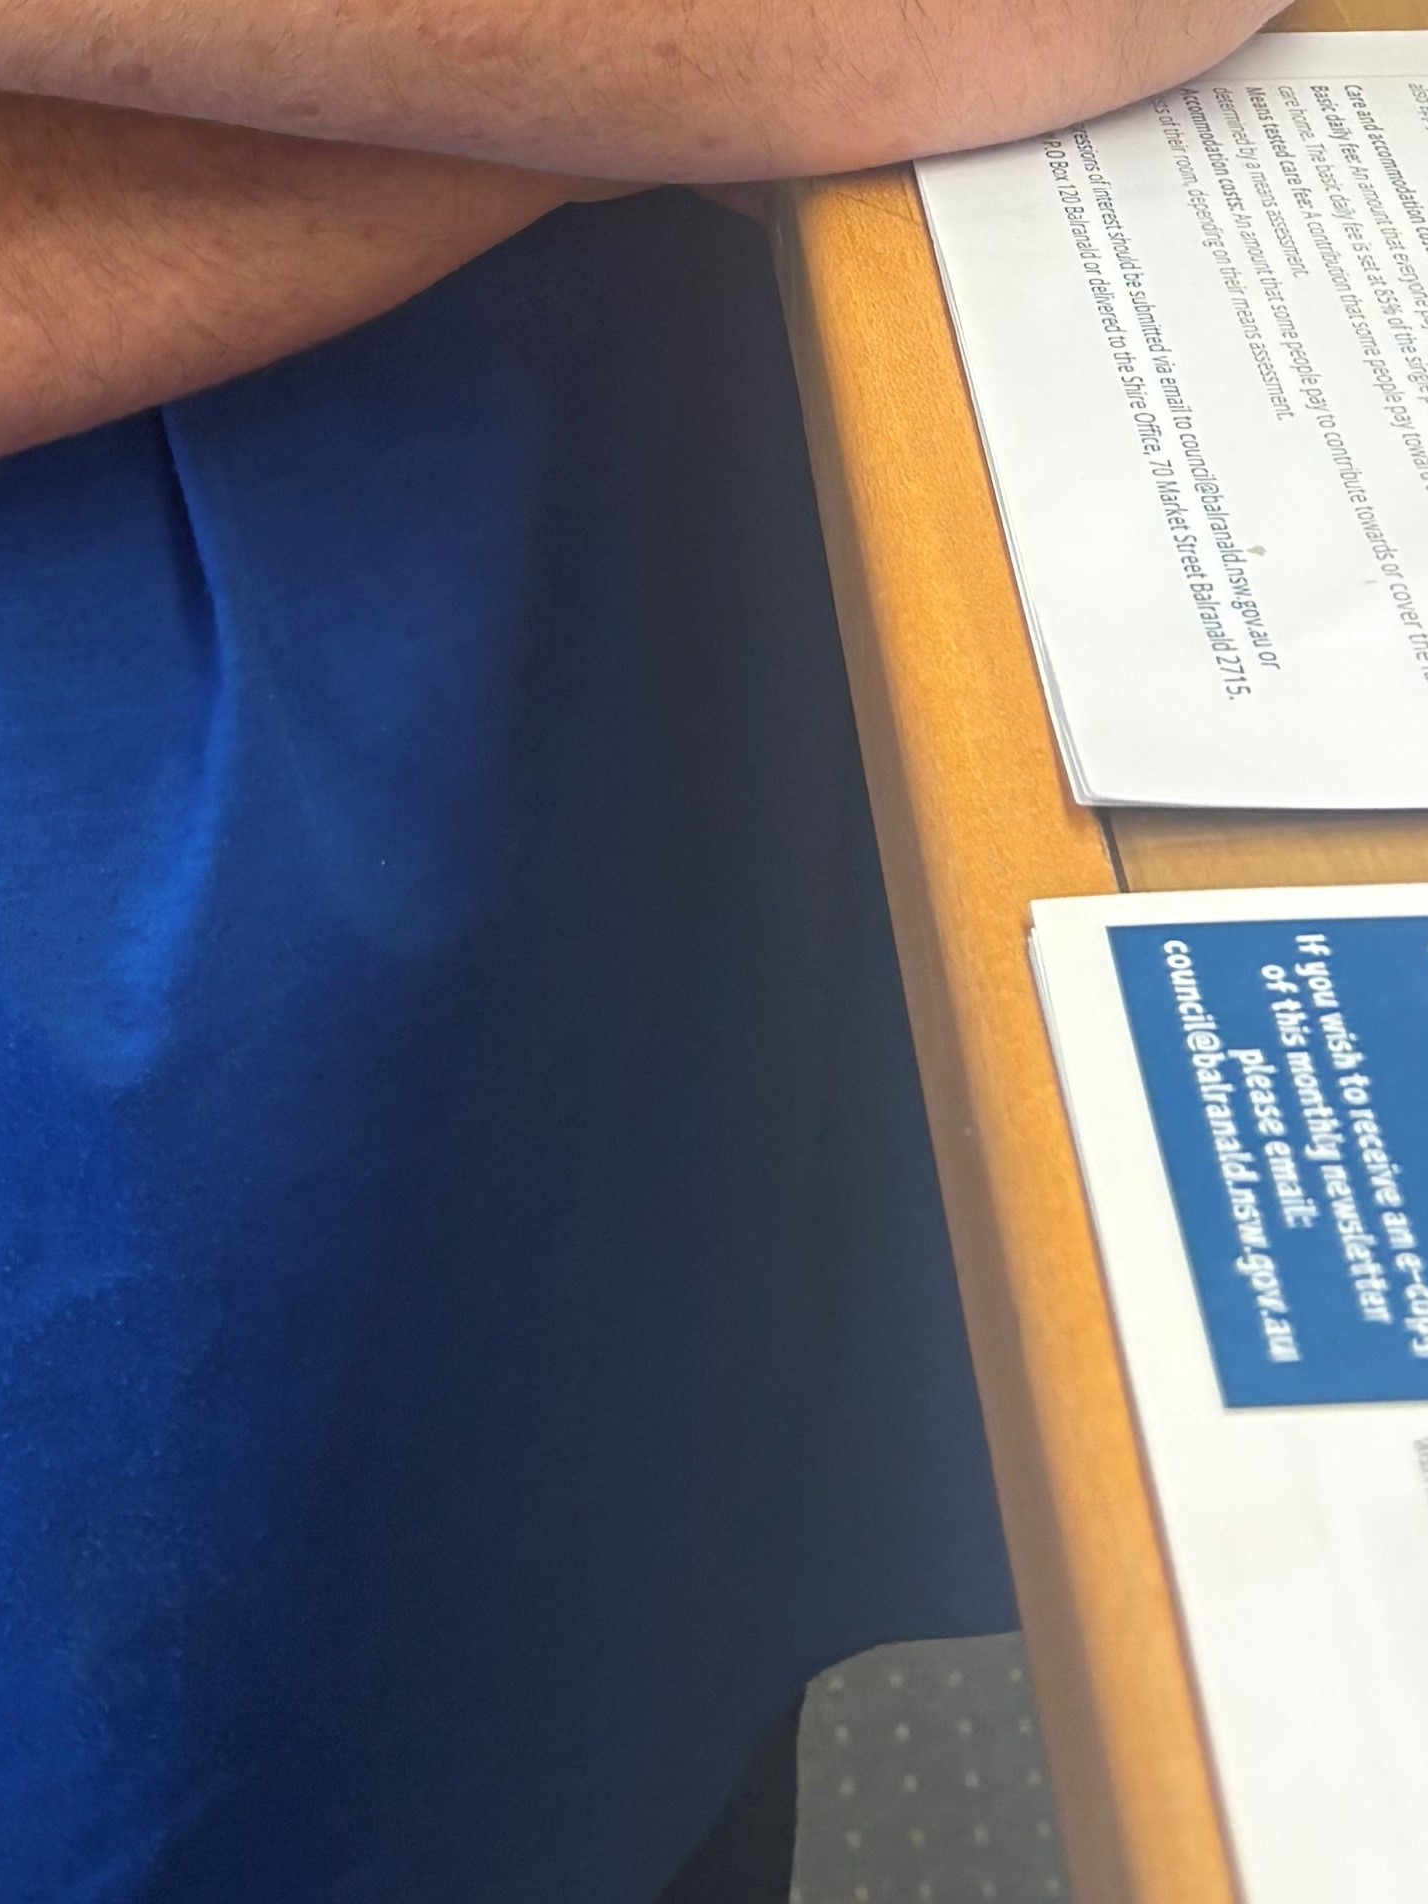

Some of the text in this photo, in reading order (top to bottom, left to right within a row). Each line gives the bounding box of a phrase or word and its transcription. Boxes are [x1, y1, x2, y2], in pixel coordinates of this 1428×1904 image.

[1245, 86, 1273, 120] Means
[1343, 84, 1366, 108] Care
[1356, 110, 1384, 131] and
[1261, 122, 1296, 157] tested
[1048, 161, 1069, 181] Box
[1278, 159, 1302, 185] care
[1367, 133, 1426, 223] accommodation
[1057, 184, 1081, 203] 120
[1290, 187, 1313, 208] fee:
[1064, 206, 1101, 258] Balranald
[1301, 211, 1322, 219] A
[1083, 262, 1101, 275] or
[1306, 221, 1351, 291] contribution
[1088, 278, 1126, 332] delivered
[1339, 293, 1365, 319] that
[1107, 335, 1126, 348] to
[1351, 321, 1380, 356] some
[1113, 351, 1136, 372] the
[1065, 126, 1280, 669] ressions of interest should be submitted via email to council@balranald.nsw.gov.au or
[1120, 375, 1147, 408] Shire
[1362, 359, 1405, 402] people
[1133, 412, 1161, 455] Office,
[1383, 405, 1415, 429] pay
[1148, 459, 1174, 476] 70
[1155, 480, 1190, 531] Market
[1172, 534, 1206, 578] Street
[1189, 583, 1238, 651] Balranald
[1215, 655, 1251, 700] 2715.
[1295, 933, 1331, 956] If
[1294, 961, 1338, 1007] you
[1319, 1012, 1364, 1069] wish
[1338, 1072, 1370, 1105] to
[1163, 939, 1299, 1361] council@balranald.nsw.gov.au
[1227, 1048, 1318, 1227] please email:
[1260, 964, 1391, 1322] of this monthly newsletter
[1348, 1108, 1402, 1207] receive
[1381, 1211, 1415, 1249] an
